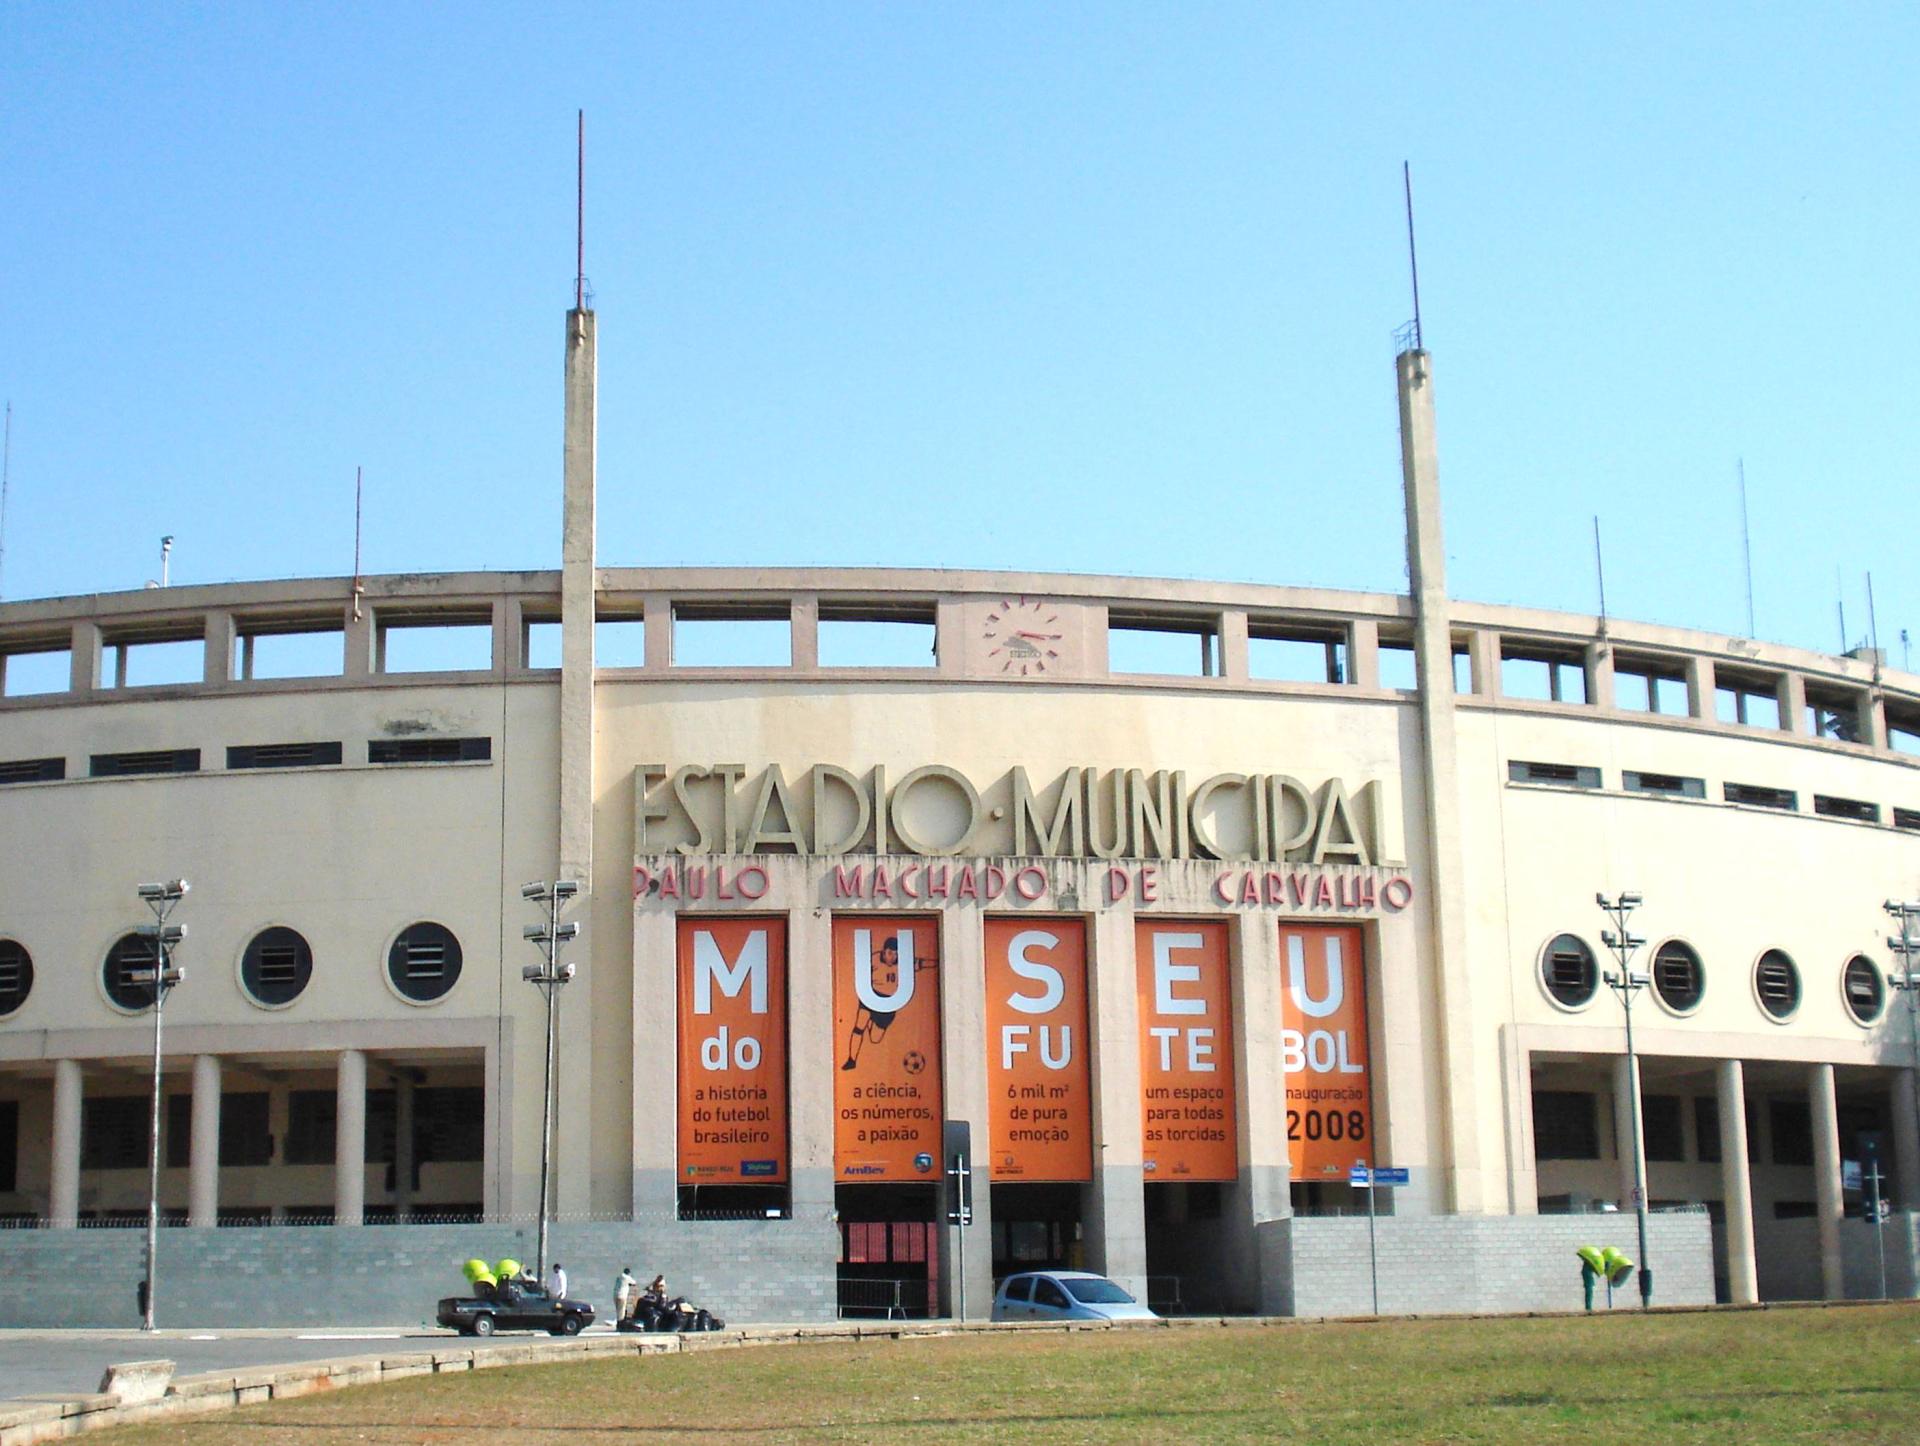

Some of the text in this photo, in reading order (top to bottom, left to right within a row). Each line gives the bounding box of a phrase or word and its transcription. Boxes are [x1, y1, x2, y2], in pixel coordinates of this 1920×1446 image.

[635, 763, 1408, 868] ESTADIO MUNICIPAL
[632, 864, 1413, 909] PAULO MACHADO DE CARVALHO
[694, 930, 768, 1015] M
[853, 929, 915, 1013] U
[1007, 929, 1066, 1015] S
[1152, 932, 1207, 1016] E
[1287, 935, 1345, 1018] U
[701, 1026, 763, 1071] do
[1001, 1025, 1072, 1071] FU
[1150, 1028, 1217, 1072] TE
[1281, 1029, 1364, 1074] BOL
[695, 1084, 768, 1100] a história
[853, 1082, 921, 1101] a ciência,
[1021, 1084, 1046, 1098] mil
[1146, 1087, 1225, 1103] um espaço
[1285, 1086, 1363, 1104] nauguração
[693, 1106, 771, 1122] do futebol
[841, 1103, 935, 1121] os números,
[1010, 1106, 1068, 1123] de pura
[1146, 1106, 1225, 1123] para todas
[857, 1125, 919, 1145] a paixão
[1009, 1126, 1070, 1144] emoção
[1146, 1126, 1226, 1142] as torcidas
[1286, 1109, 1365, 1141] 2008
[694, 1127, 770, 1144] brasileiro
